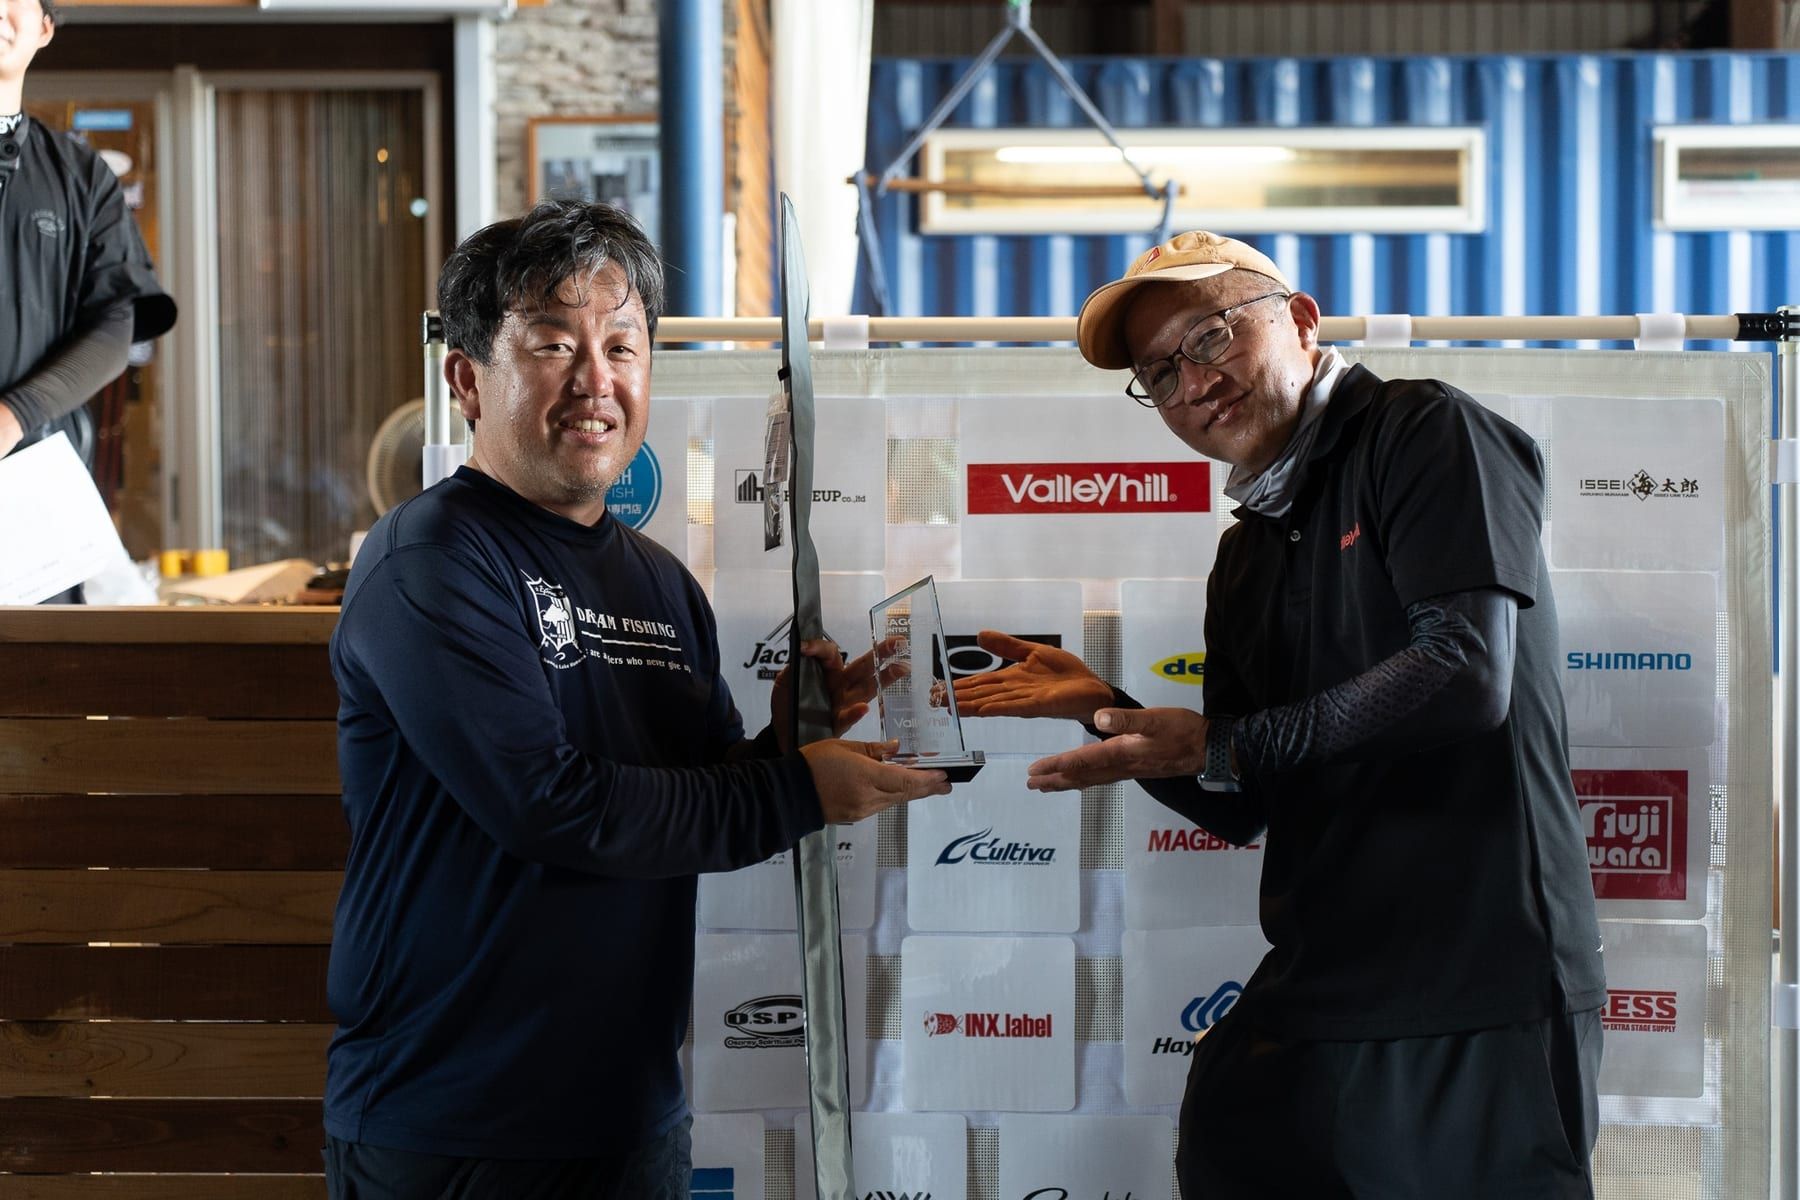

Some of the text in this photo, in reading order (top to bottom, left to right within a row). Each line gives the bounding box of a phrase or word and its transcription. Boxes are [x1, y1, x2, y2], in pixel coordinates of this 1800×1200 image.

[1001, 472, 1169, 507] Valleyhill
[1580, 479, 1626, 490] ISSEI
[621, 617, 677, 639] FISHING
[626, 656, 643, 666] who
[1567, 652, 1692, 671] SHIMANO
[964, 1013, 1052, 1038] INX.label
[1631, 1024, 1651, 1032] STAGE
[1652, 1025, 1676, 1033] SUPPLY
